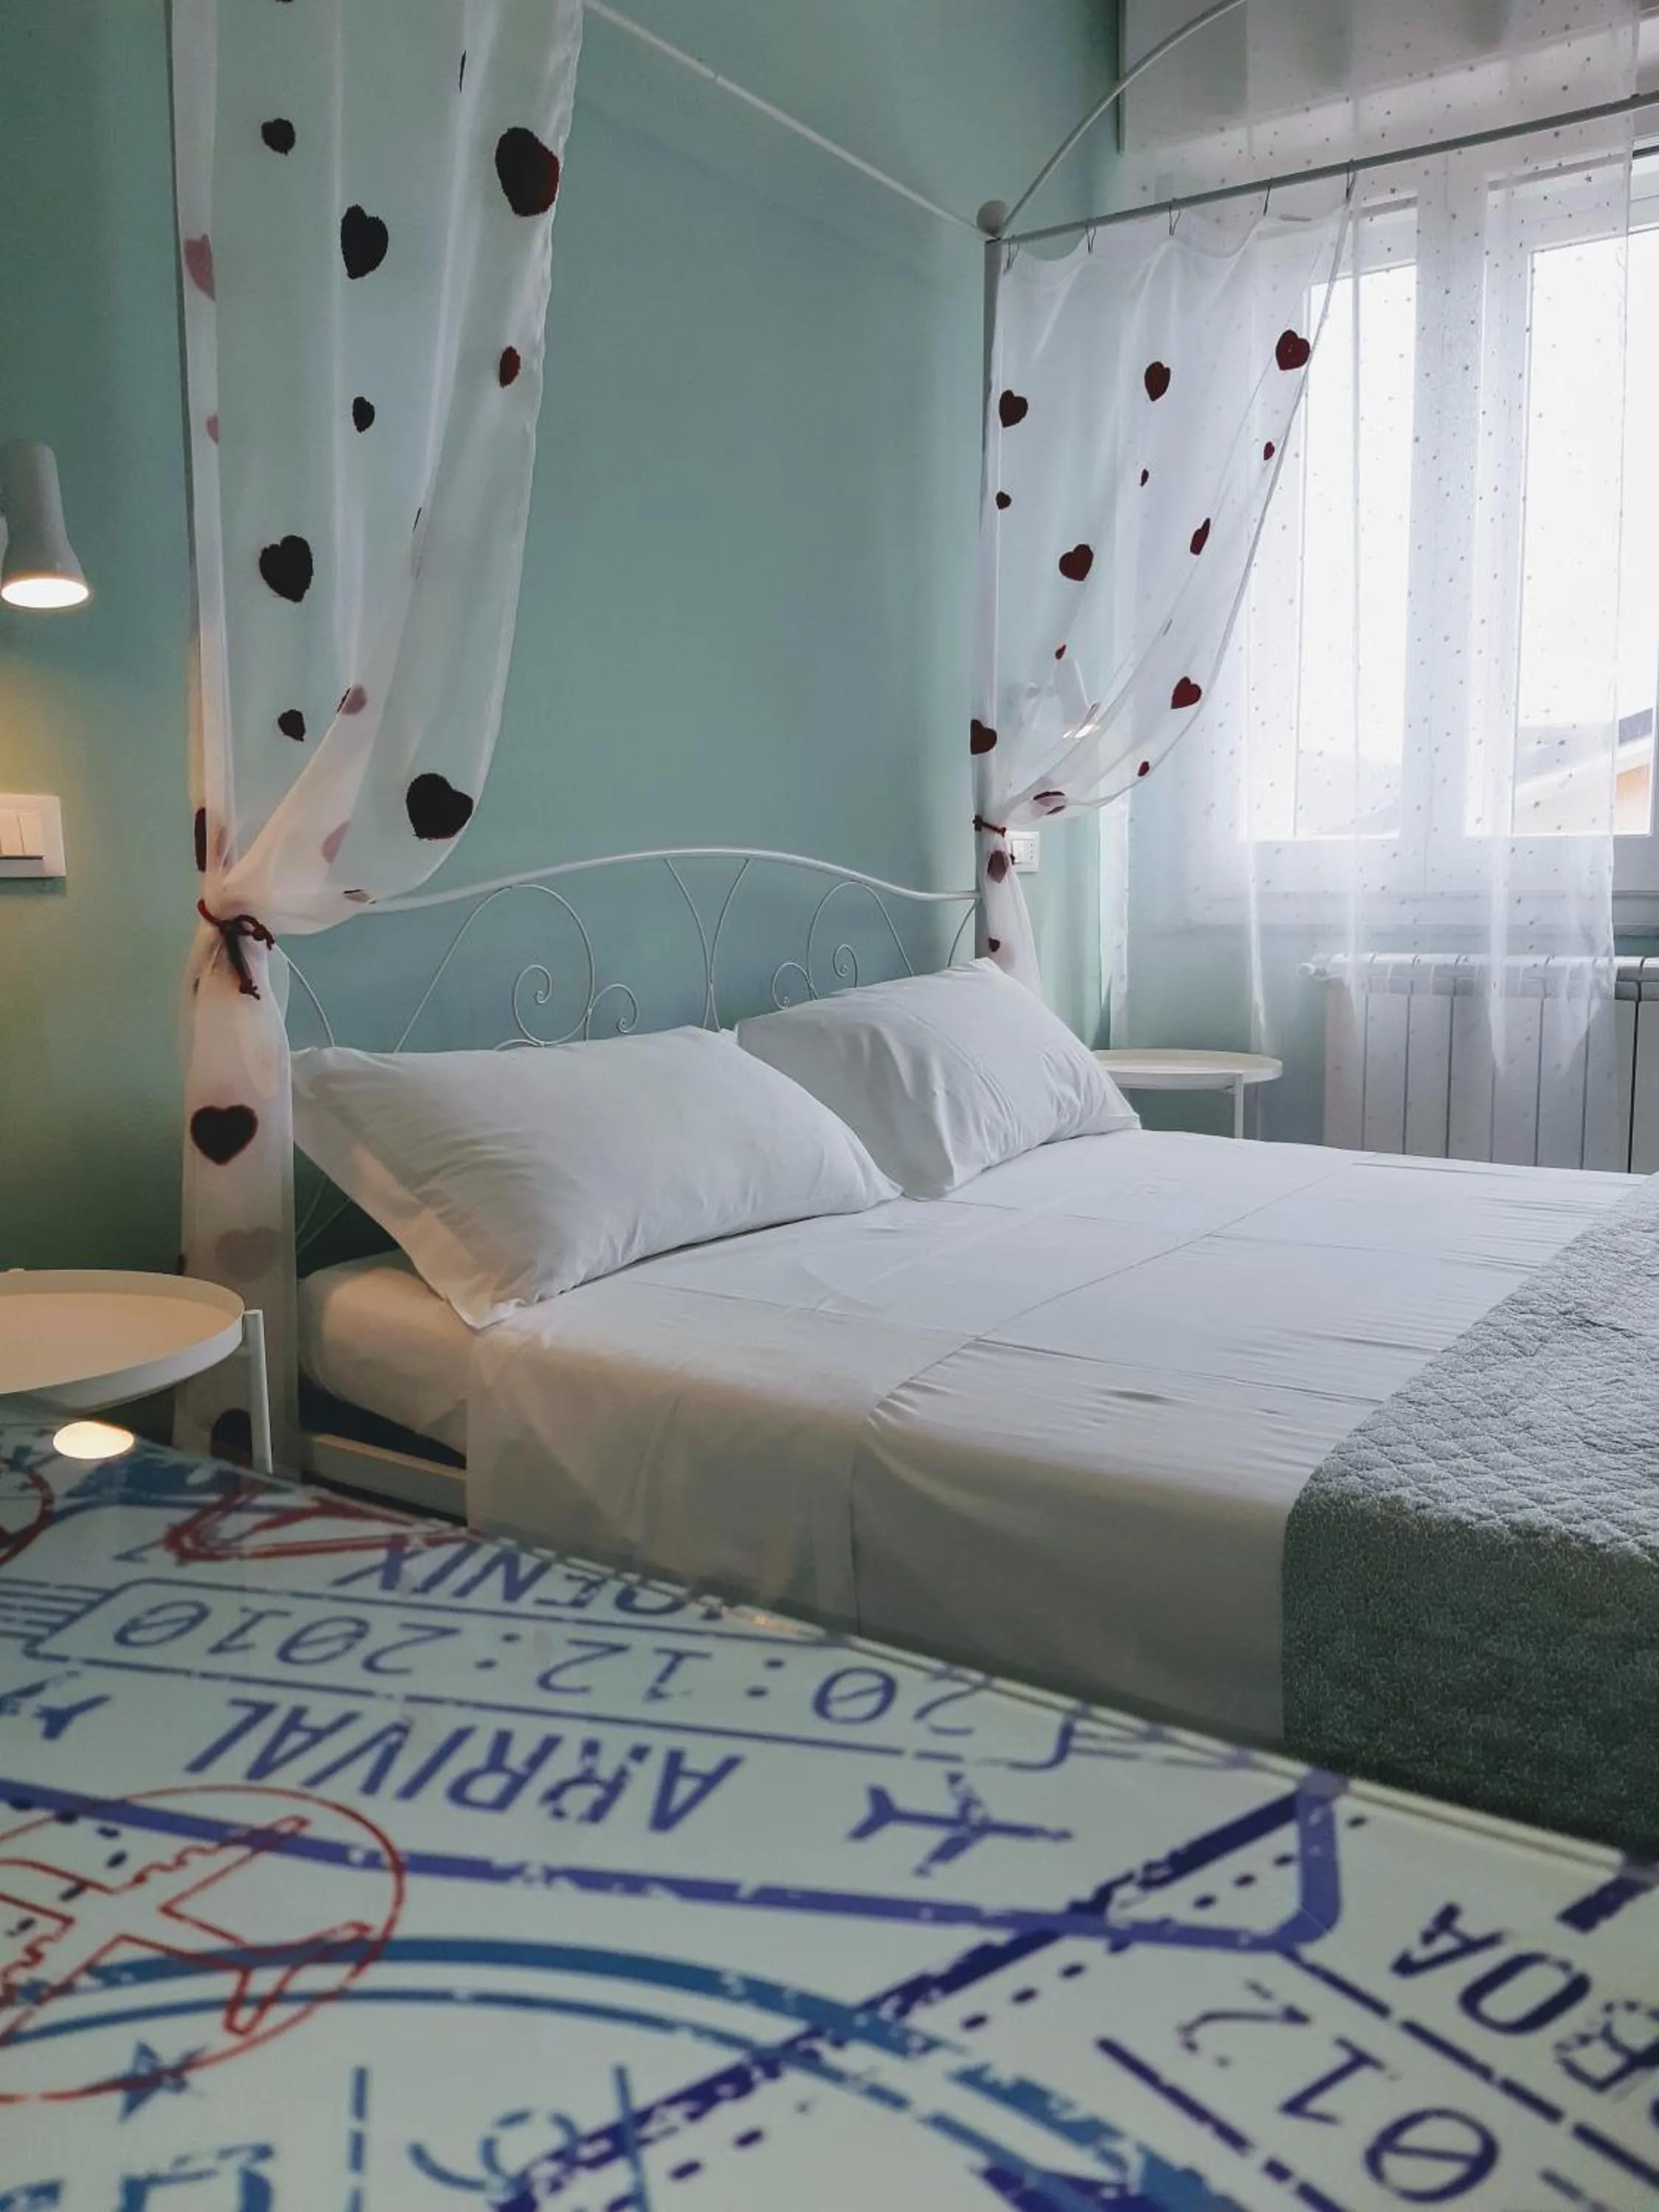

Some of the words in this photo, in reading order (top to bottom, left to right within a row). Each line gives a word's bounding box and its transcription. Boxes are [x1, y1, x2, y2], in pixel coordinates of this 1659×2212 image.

[184, 1698, 743, 1833] ARRIVAL
[1178, 1980, 1615, 2212] 012
[1389, 1902, 1659, 2131] BOA
